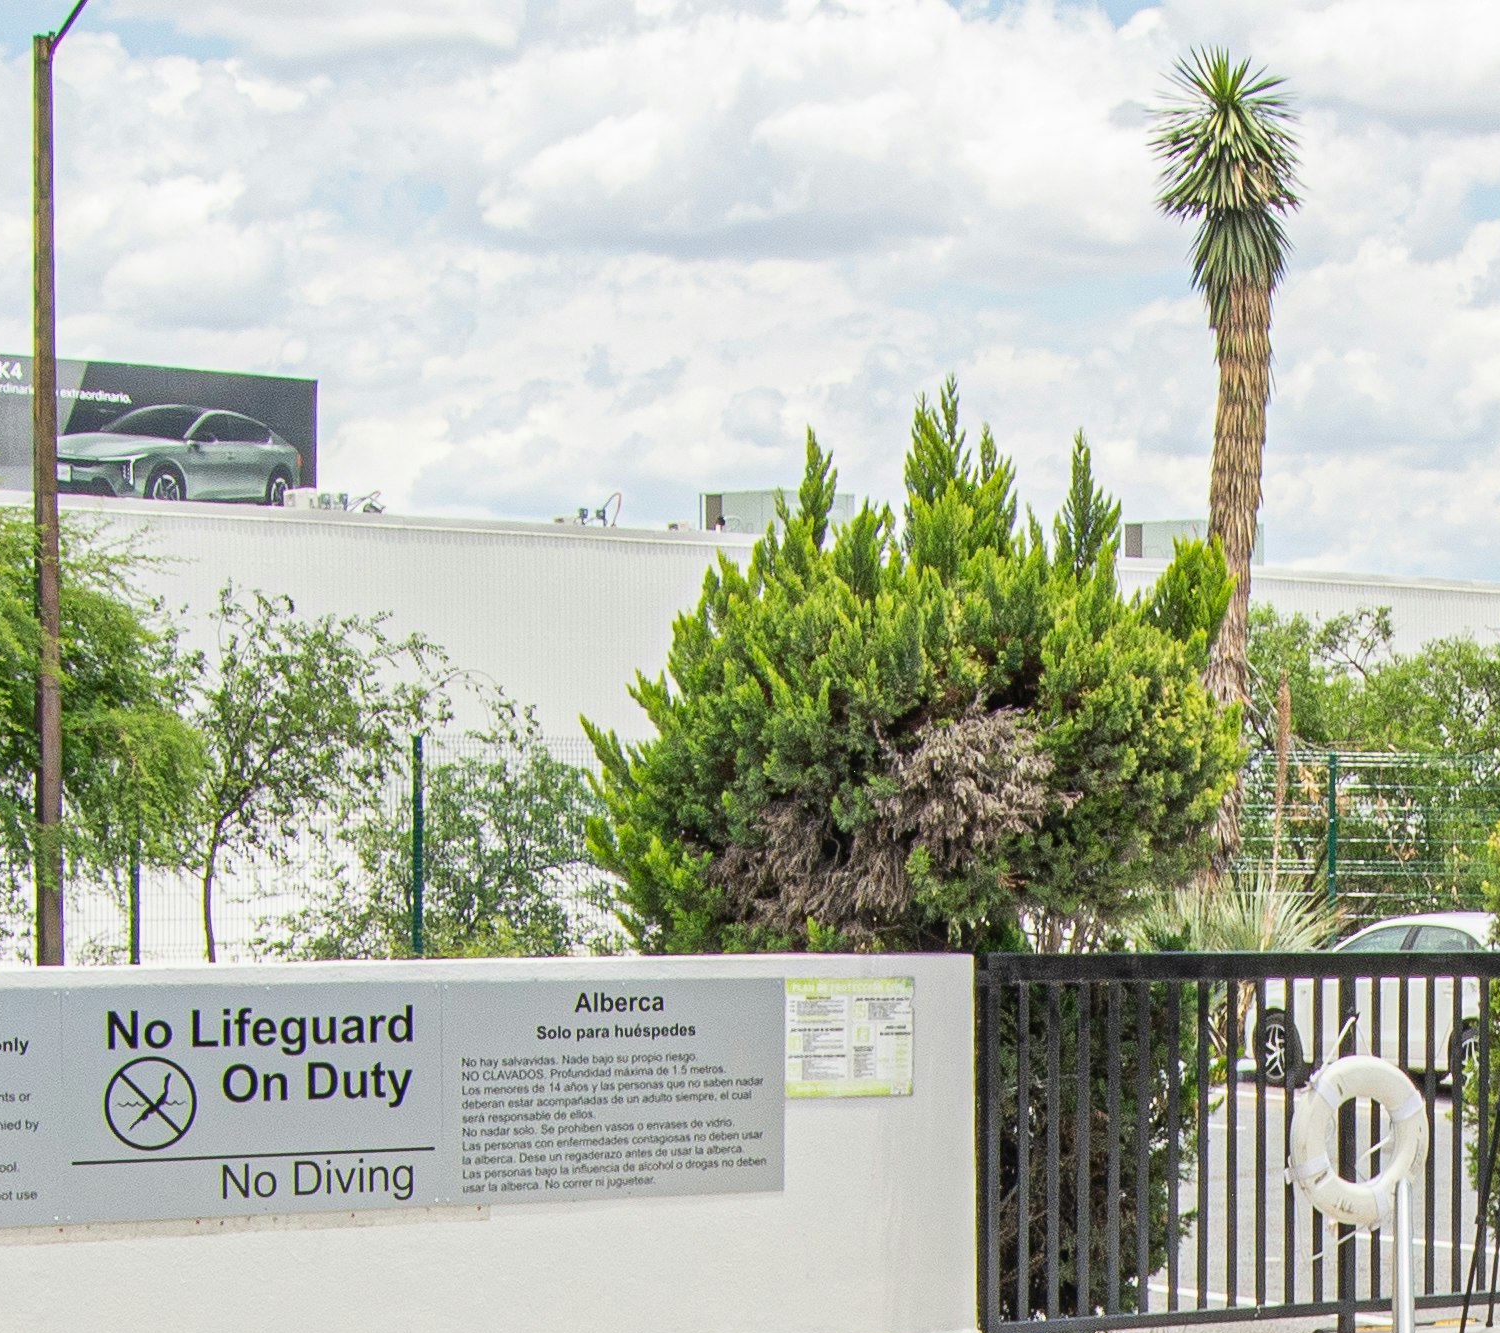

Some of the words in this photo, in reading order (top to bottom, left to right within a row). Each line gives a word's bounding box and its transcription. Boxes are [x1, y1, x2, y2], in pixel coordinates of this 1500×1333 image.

[574, 990, 664, 1013] Alberca
[106, 1009, 173, 1050] No
[190, 1004, 414, 1056] Lifeguard
[536, 1024, 571, 1040] Solo
[576, 1027, 609, 1042] para
[614, 1021, 696, 1041] huéspedes
[221, 1063, 288, 1103] On
[306, 1060, 413, 1108] Duty
[18, 1092, 31, 1102] or
[24, 1118, 39, 1130] by
[221, 1162, 278, 1200] No
[292, 1157, 415, 1201] Diving
[16, 1190, 37, 1201] use
